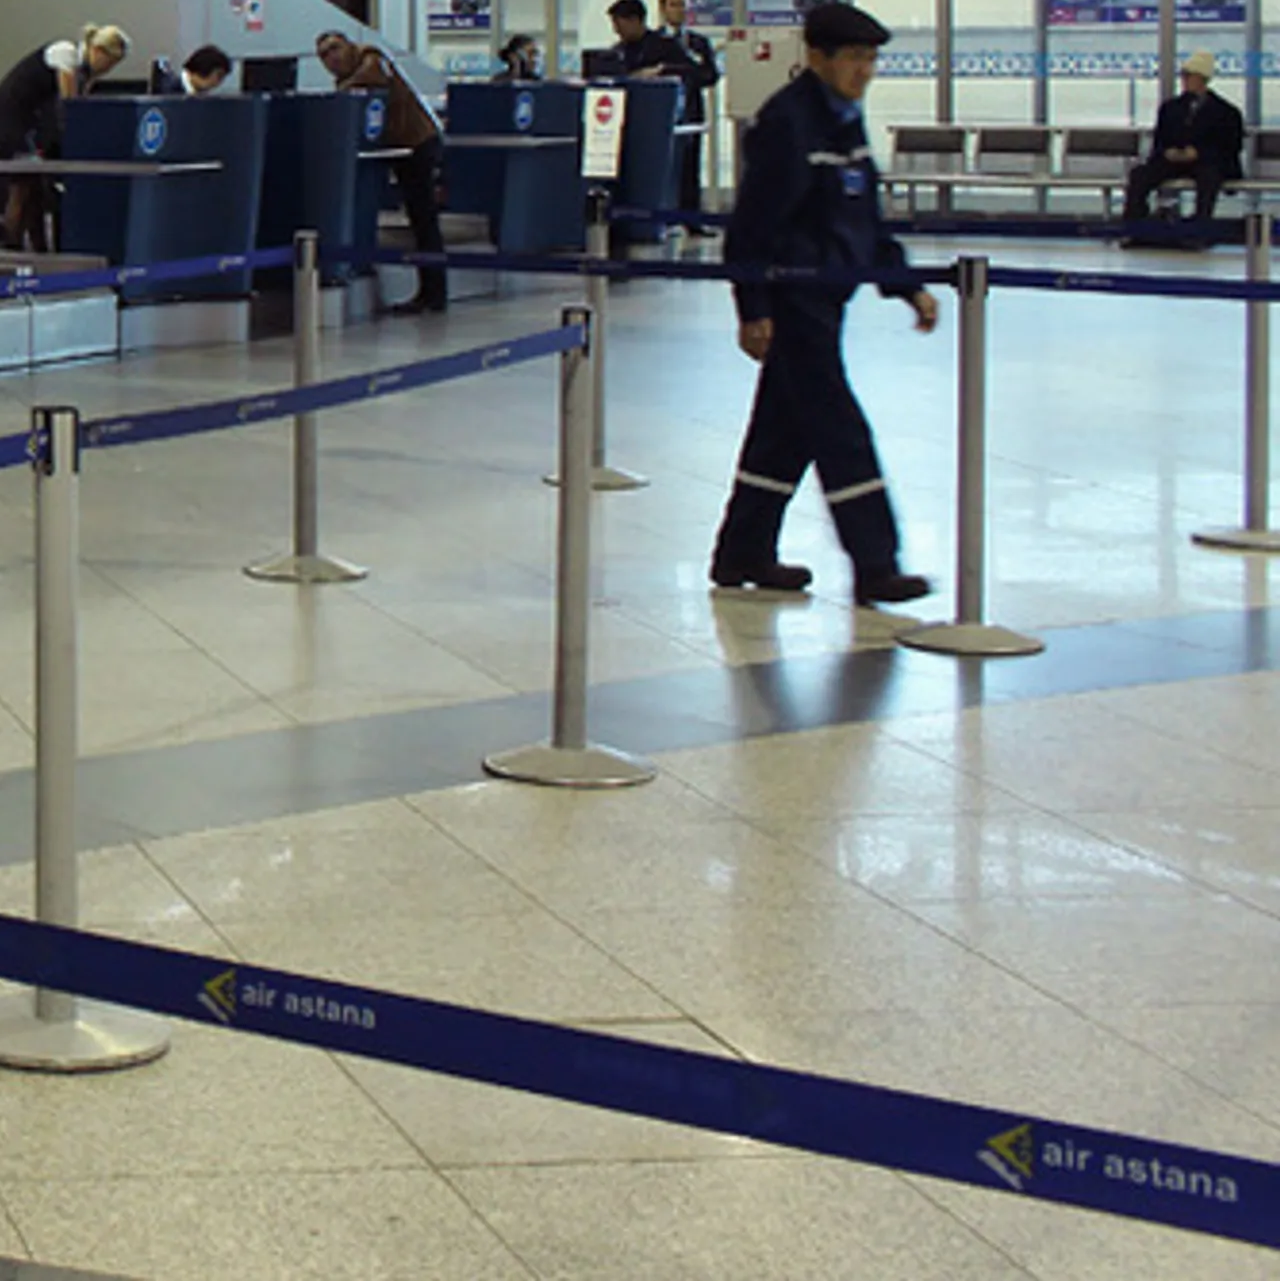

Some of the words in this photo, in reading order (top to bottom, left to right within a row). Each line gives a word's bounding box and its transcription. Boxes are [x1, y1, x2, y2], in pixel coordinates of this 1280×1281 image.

[239, 978, 276, 1009] air
[284, 988, 377, 1032] astana
[1042, 1139, 1093, 1172] air
[1102, 1152, 1240, 1204] astana
